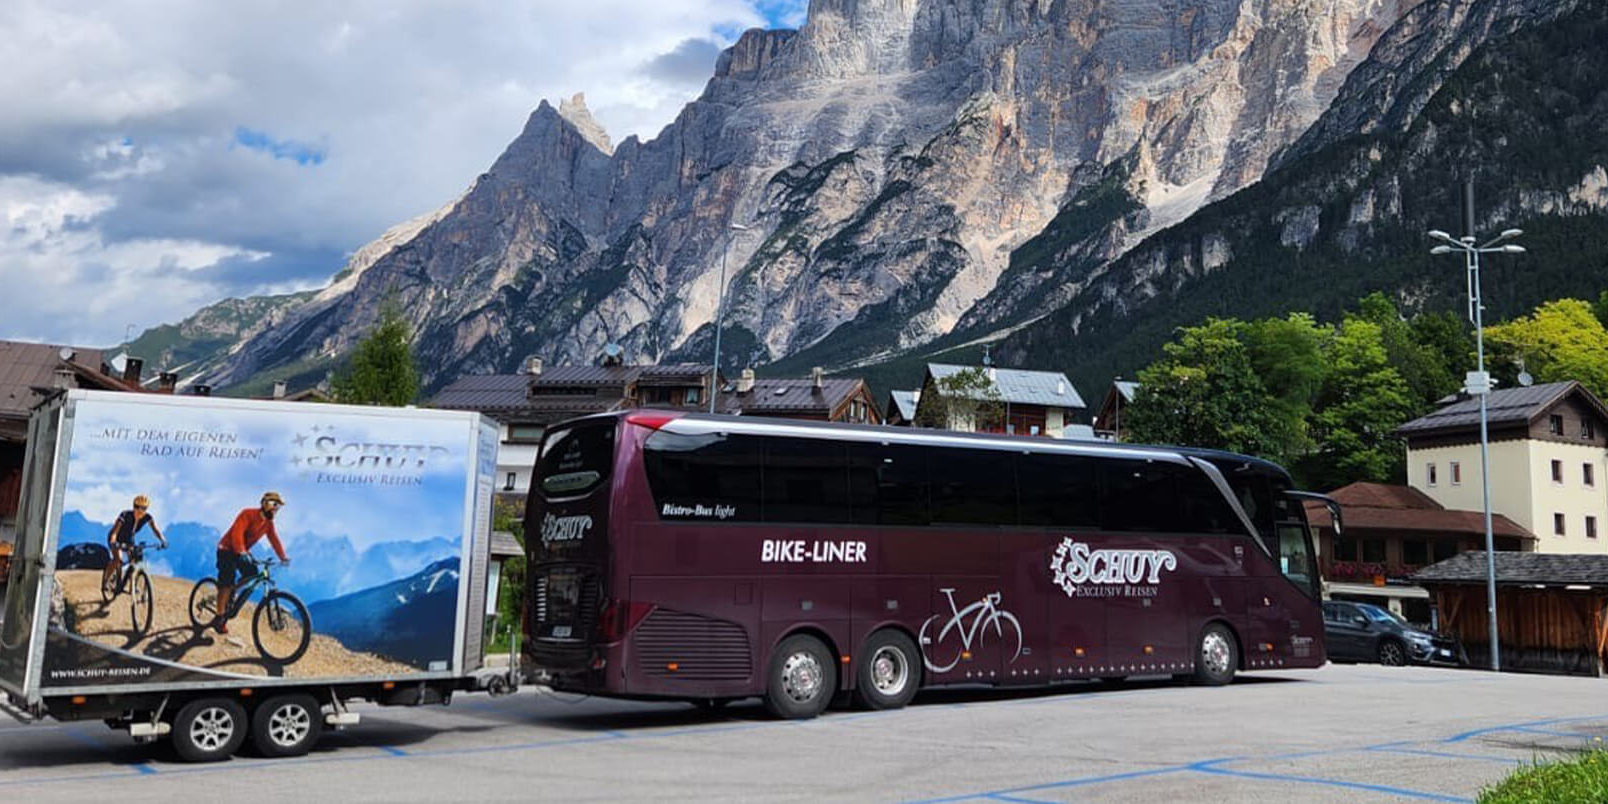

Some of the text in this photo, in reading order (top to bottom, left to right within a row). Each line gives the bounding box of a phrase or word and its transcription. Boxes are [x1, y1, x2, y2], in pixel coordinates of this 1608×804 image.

[136, 429, 169, 441] DEM
[174, 430, 238, 444] EIGENEN
[140, 443, 264, 460] RAD AUF REISEN!
[379, 473, 423, 486] REISEN
[662, 503, 713, 516] Bistro-Bus
[547, 514, 593, 541] SCHUY
[761, 539, 867, 562] BIKE-LINER
[1065, 542, 1177, 584] SCHUY
[1076, 584, 1158, 598] EXCLUSIV REISEN
